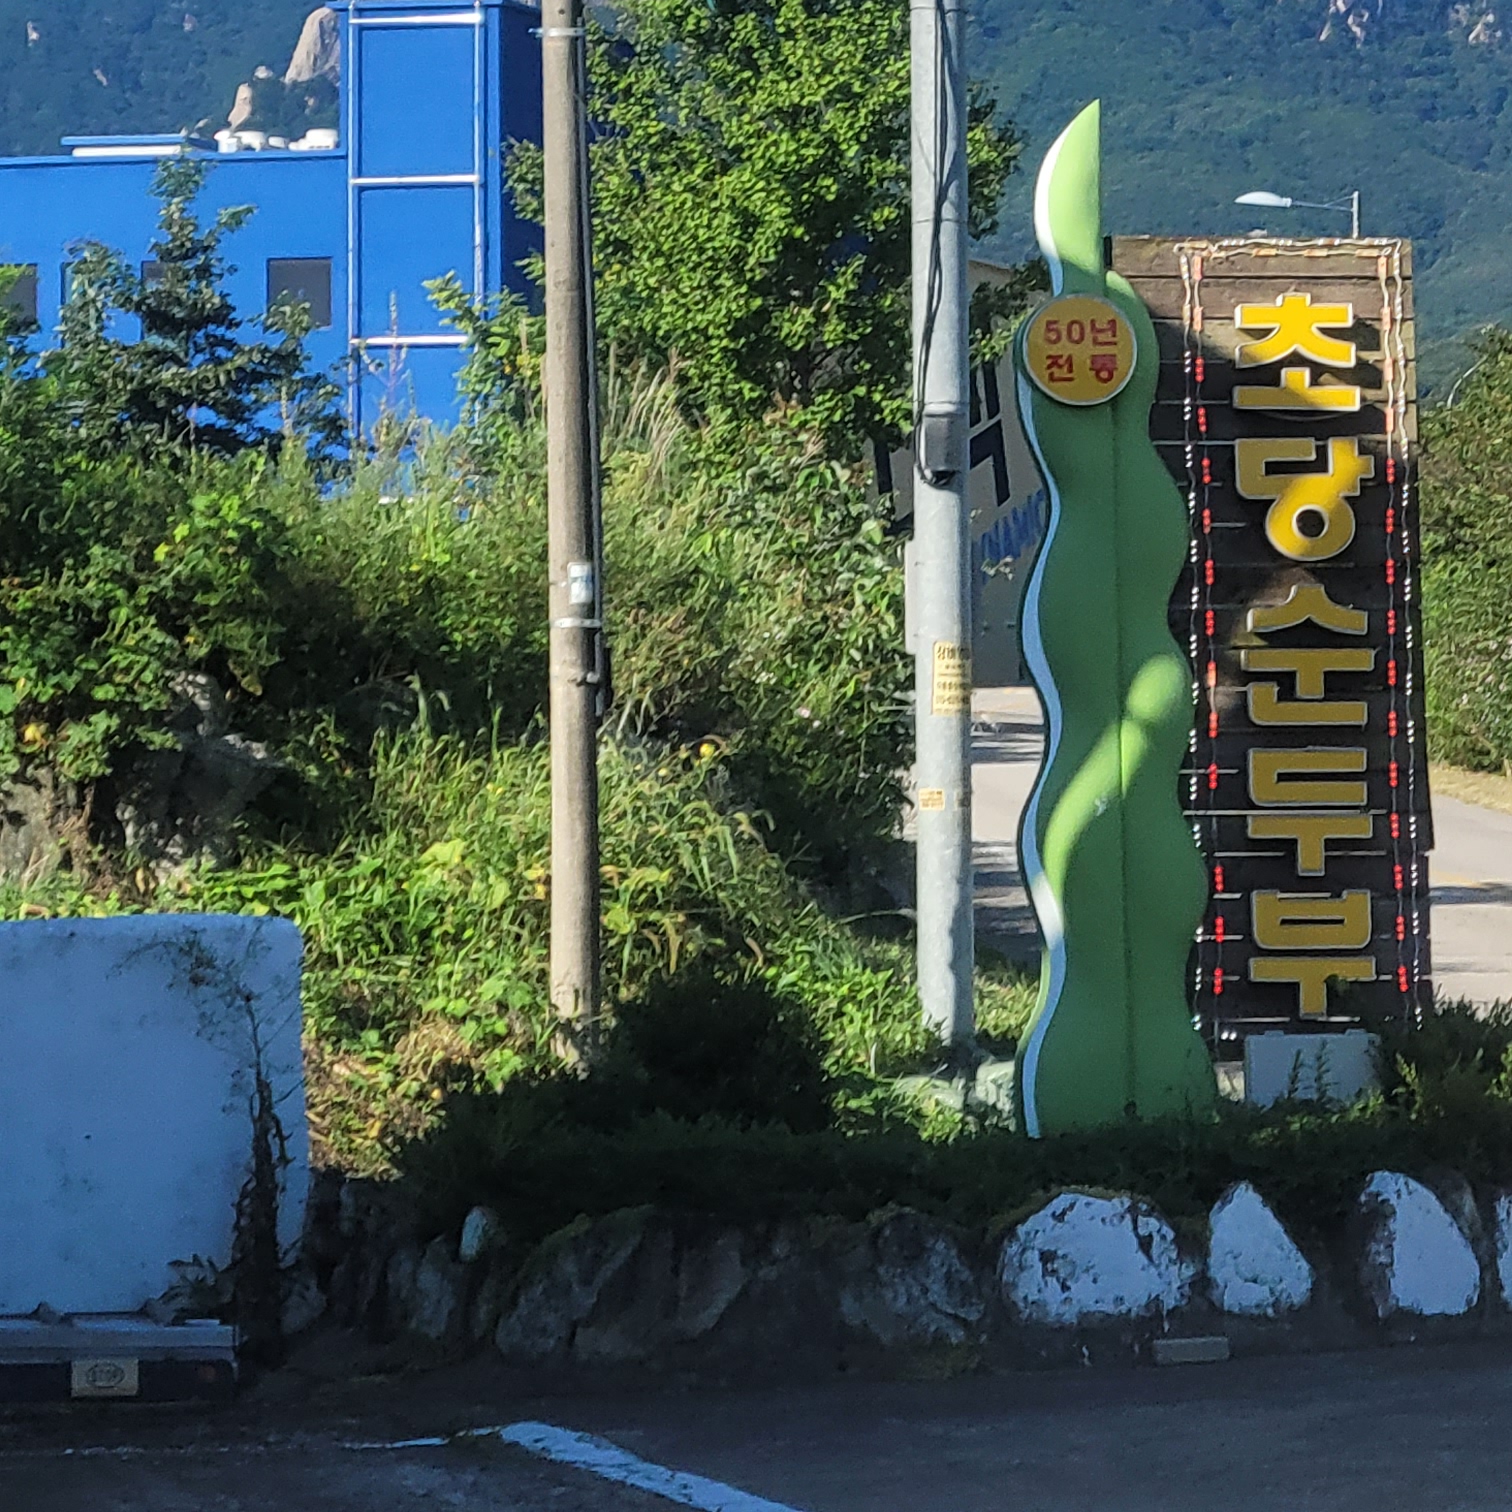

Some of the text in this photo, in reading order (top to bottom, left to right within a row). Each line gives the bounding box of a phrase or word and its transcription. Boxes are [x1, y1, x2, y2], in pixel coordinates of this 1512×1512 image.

[1044, 318, 1117, 346] 50년
[1045, 354, 1118, 384] 전통
[1232, 292, 1377, 1020] 초당순두부
